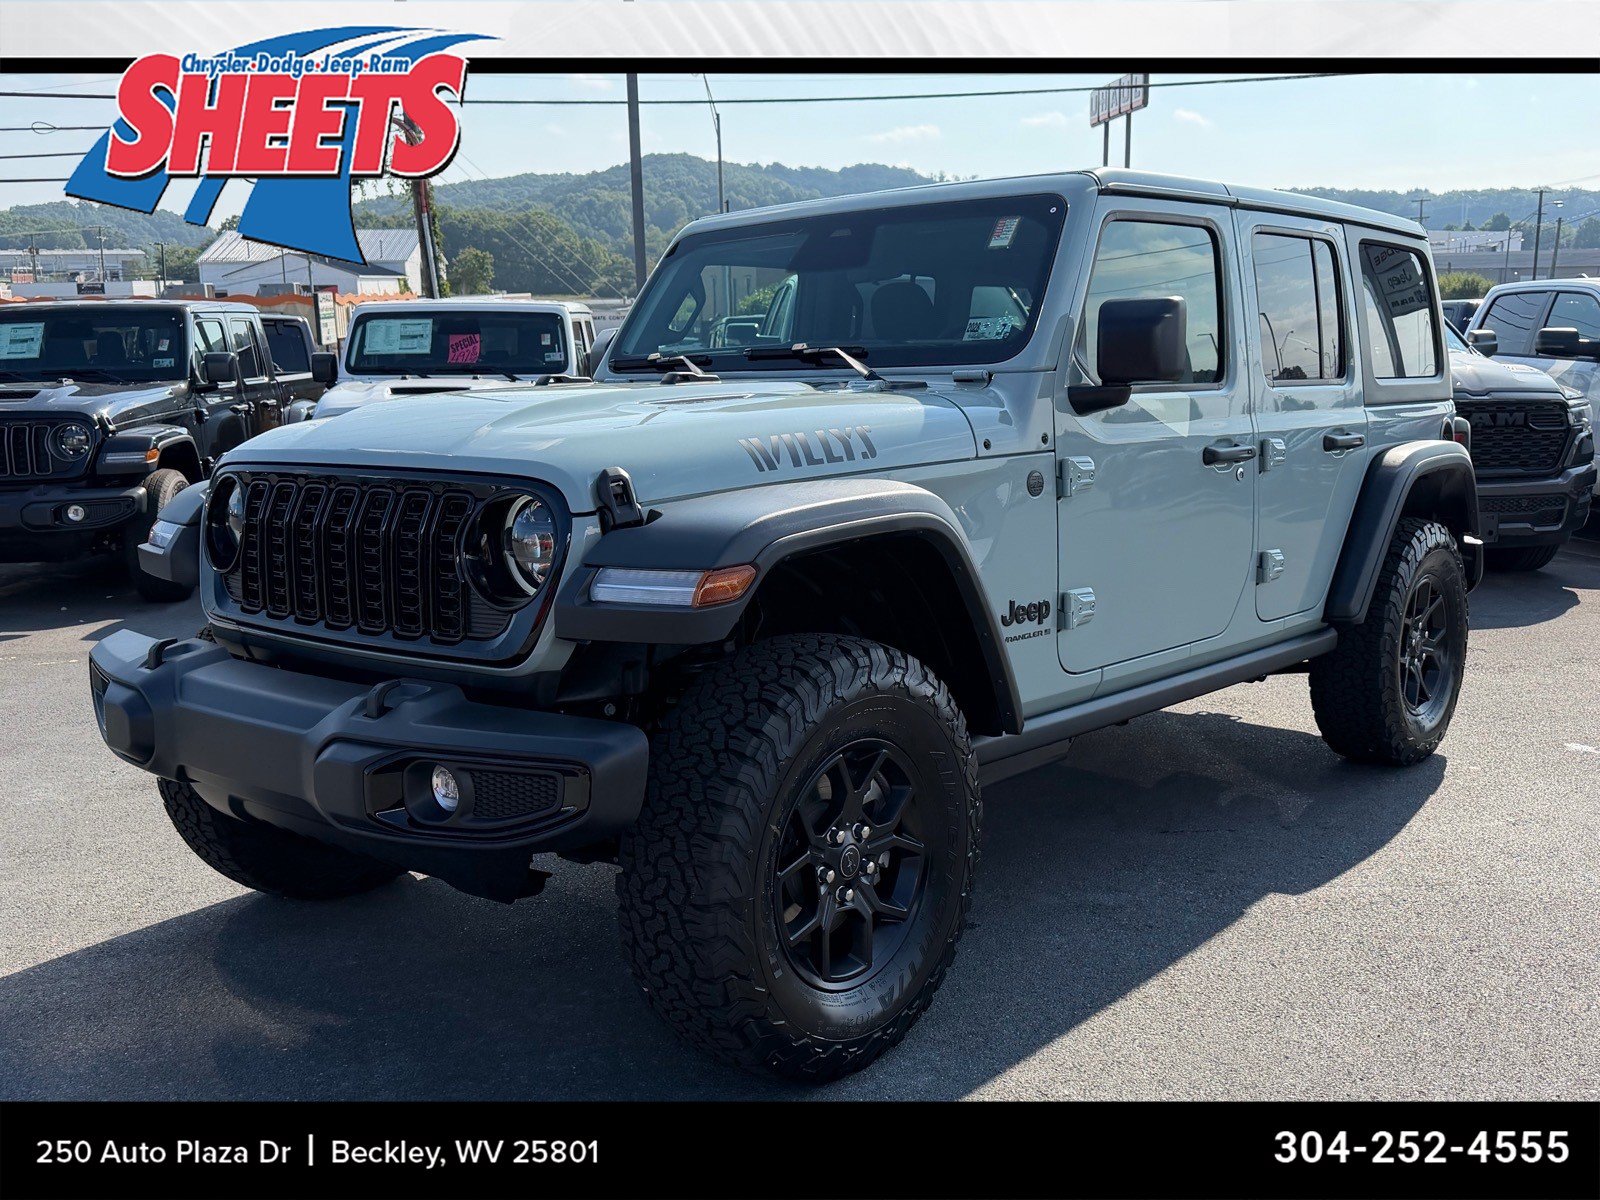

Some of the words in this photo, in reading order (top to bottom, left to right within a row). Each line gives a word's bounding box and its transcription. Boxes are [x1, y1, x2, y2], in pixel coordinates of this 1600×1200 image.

[450, 333, 479, 354] SPECIAL
[1469, 412, 1526, 427] AM
[738, 425, 877, 473] WILLYS
[1001, 599, 1050, 627] Jeep
